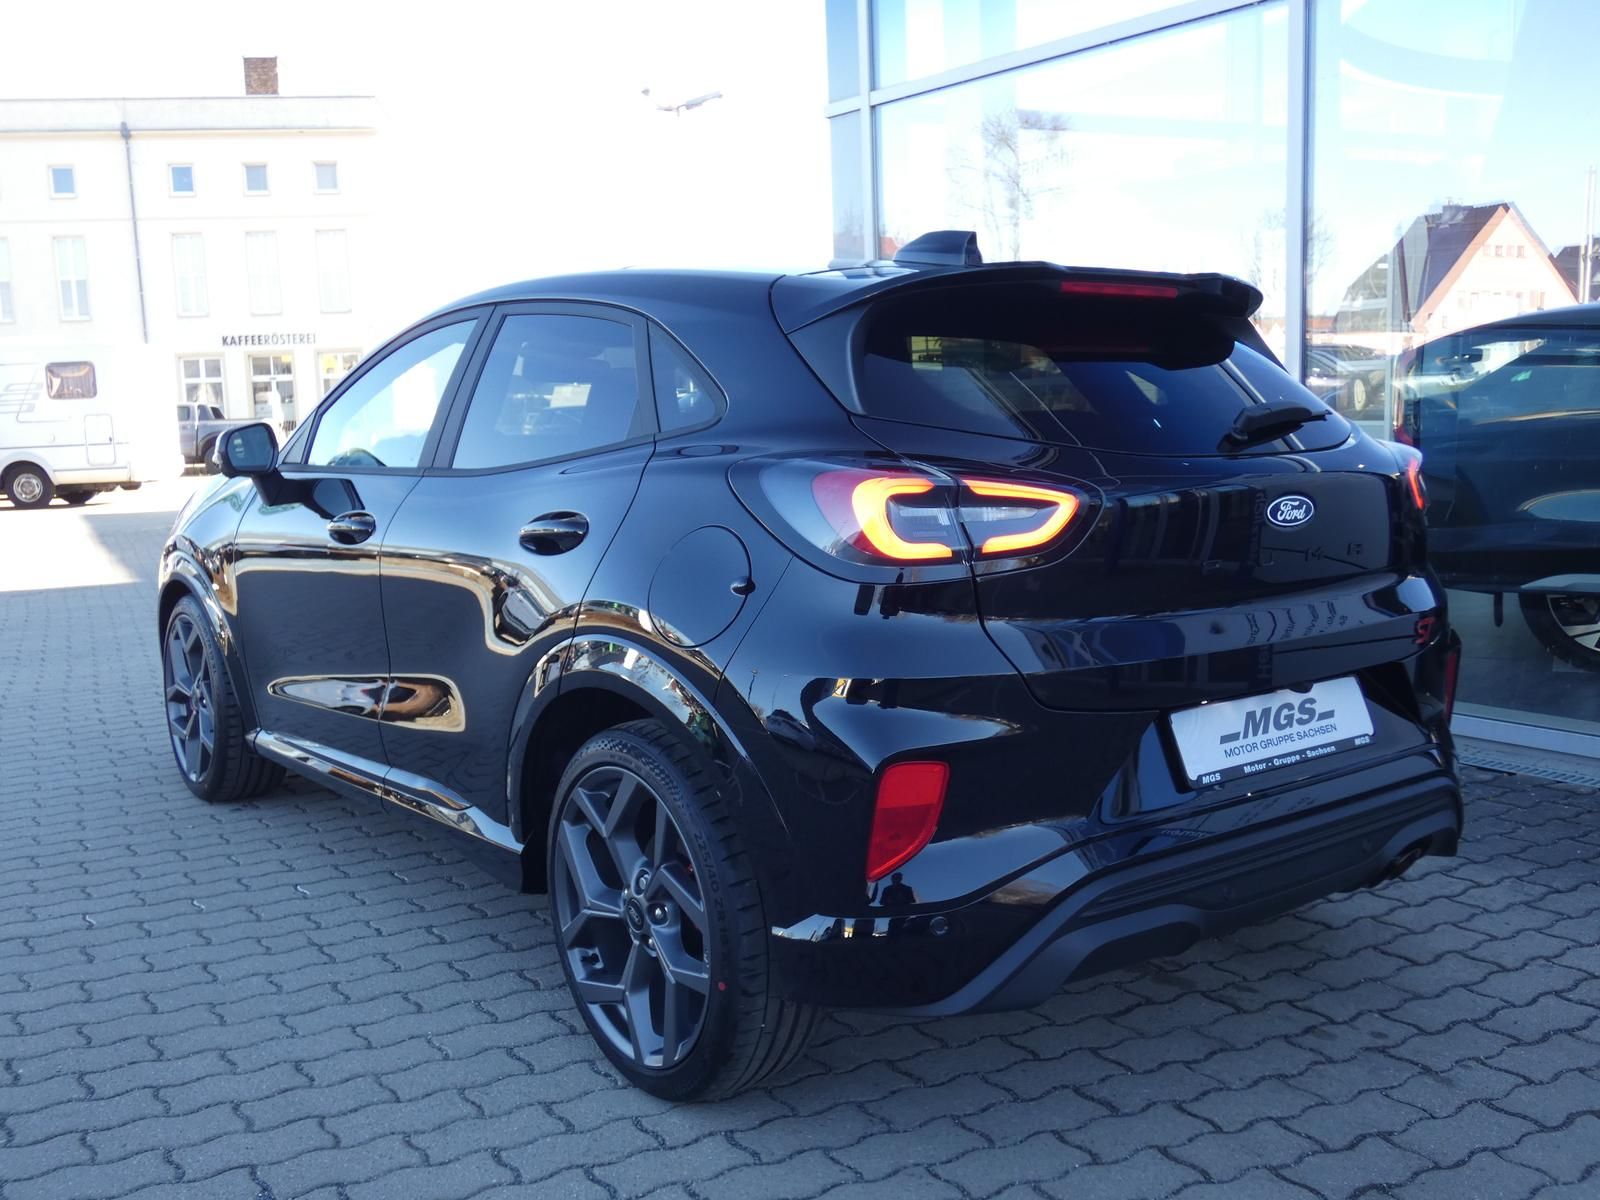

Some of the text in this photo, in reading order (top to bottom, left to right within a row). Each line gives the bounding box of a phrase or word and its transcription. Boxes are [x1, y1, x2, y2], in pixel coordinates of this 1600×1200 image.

[222, 333, 317, 346] KAFFEERÖSTEREI
[1277, 501, 1306, 521] Ford
[1242, 698, 1317, 739] MGS
[1224, 723, 1338, 758] MOTOR GRUPPE SACHSEN
[1202, 772, 1221, 785] MGS
[1244, 762, 1267, 774] Motor
[1273, 754, 1301, 768] Gruppe
[1306, 745, 1336, 758] Sachsen
[1354, 735, 1370, 746] MGS
[694, 832, 720, 893] 225/40
[714, 898, 726, 923] ZR
